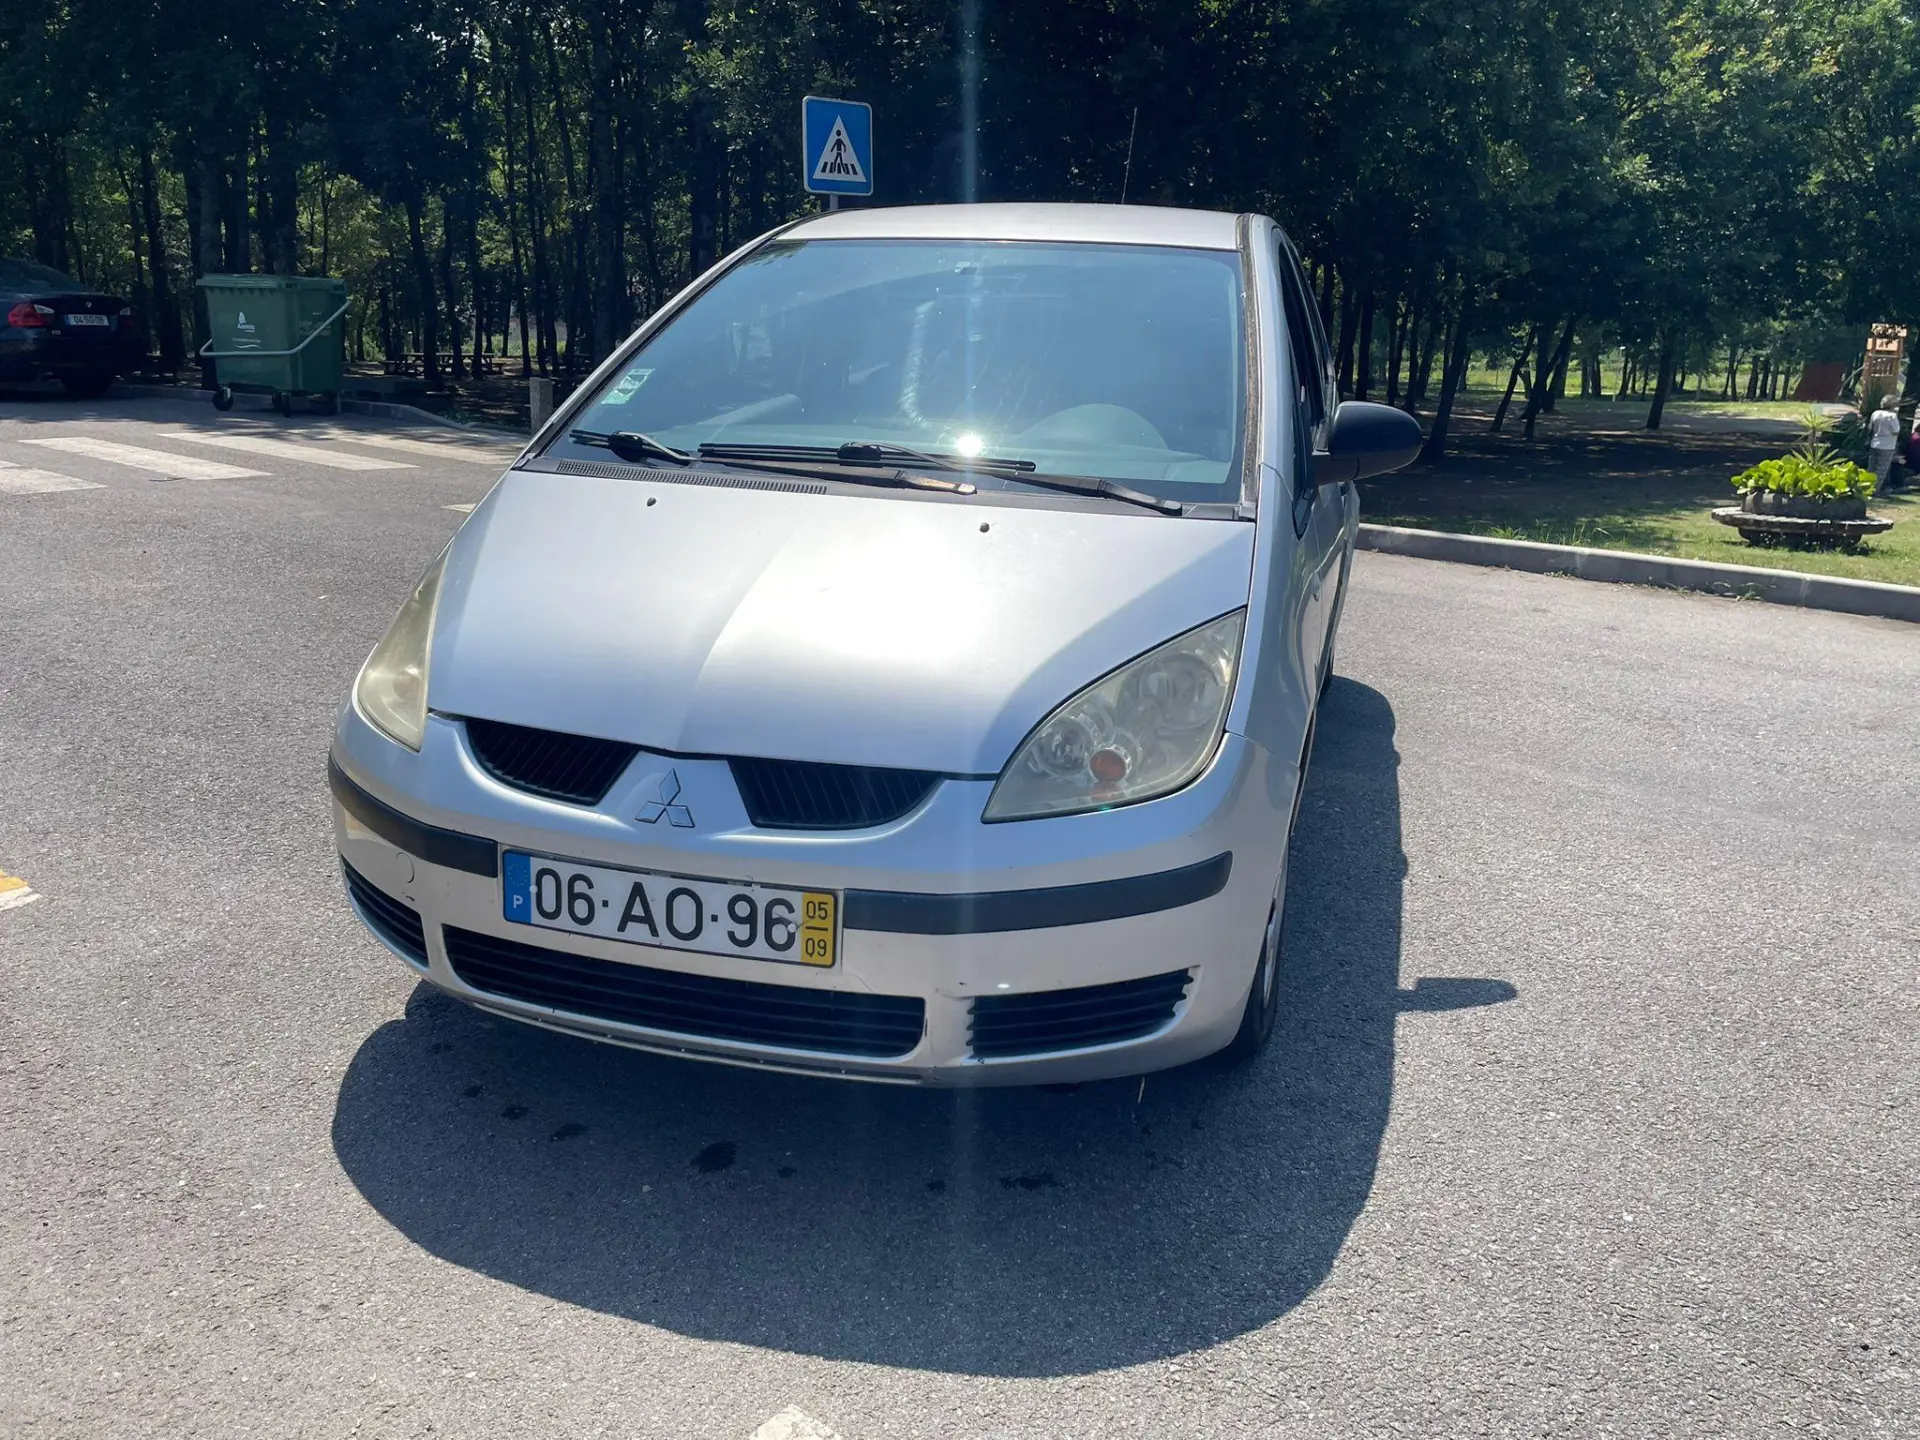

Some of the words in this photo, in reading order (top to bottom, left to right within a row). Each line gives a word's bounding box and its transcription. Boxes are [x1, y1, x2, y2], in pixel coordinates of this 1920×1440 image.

[512, 894, 523, 909] P
[805, 900, 829, 921] 05
[805, 937, 828, 958] 09
